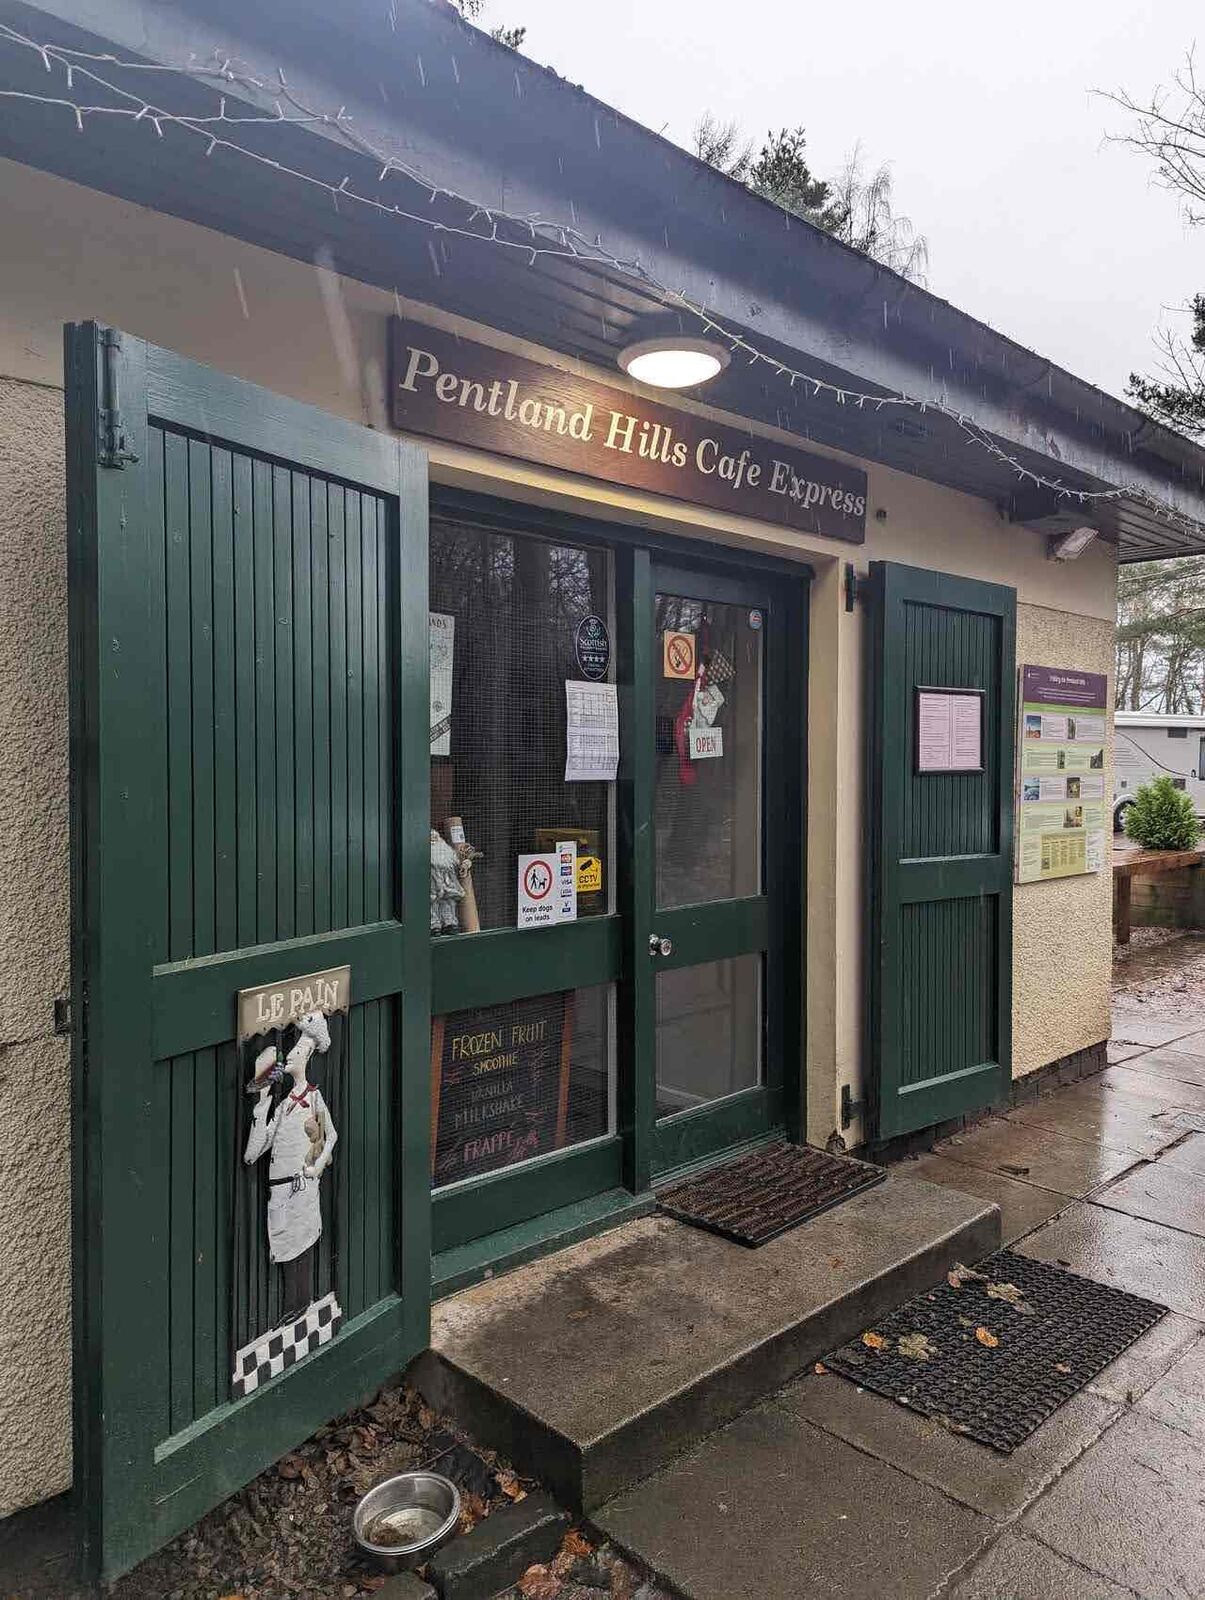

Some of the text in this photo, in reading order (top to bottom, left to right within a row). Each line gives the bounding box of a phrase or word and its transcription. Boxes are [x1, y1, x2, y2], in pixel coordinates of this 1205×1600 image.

[399, 346, 866, 517] Pentland Hills Cafe Express
[695, 736, 717, 753] OPEN
[579, 874, 598, 884] CCTV
[522, 903, 553, 914] Keep dogs
[534, 914, 550, 922] leads
[256, 978, 339, 1023] LE PAIN
[452, 1020, 548, 1062] FROZEN FRUIT
[472, 1051, 520, 1077] SMOOTHIE
